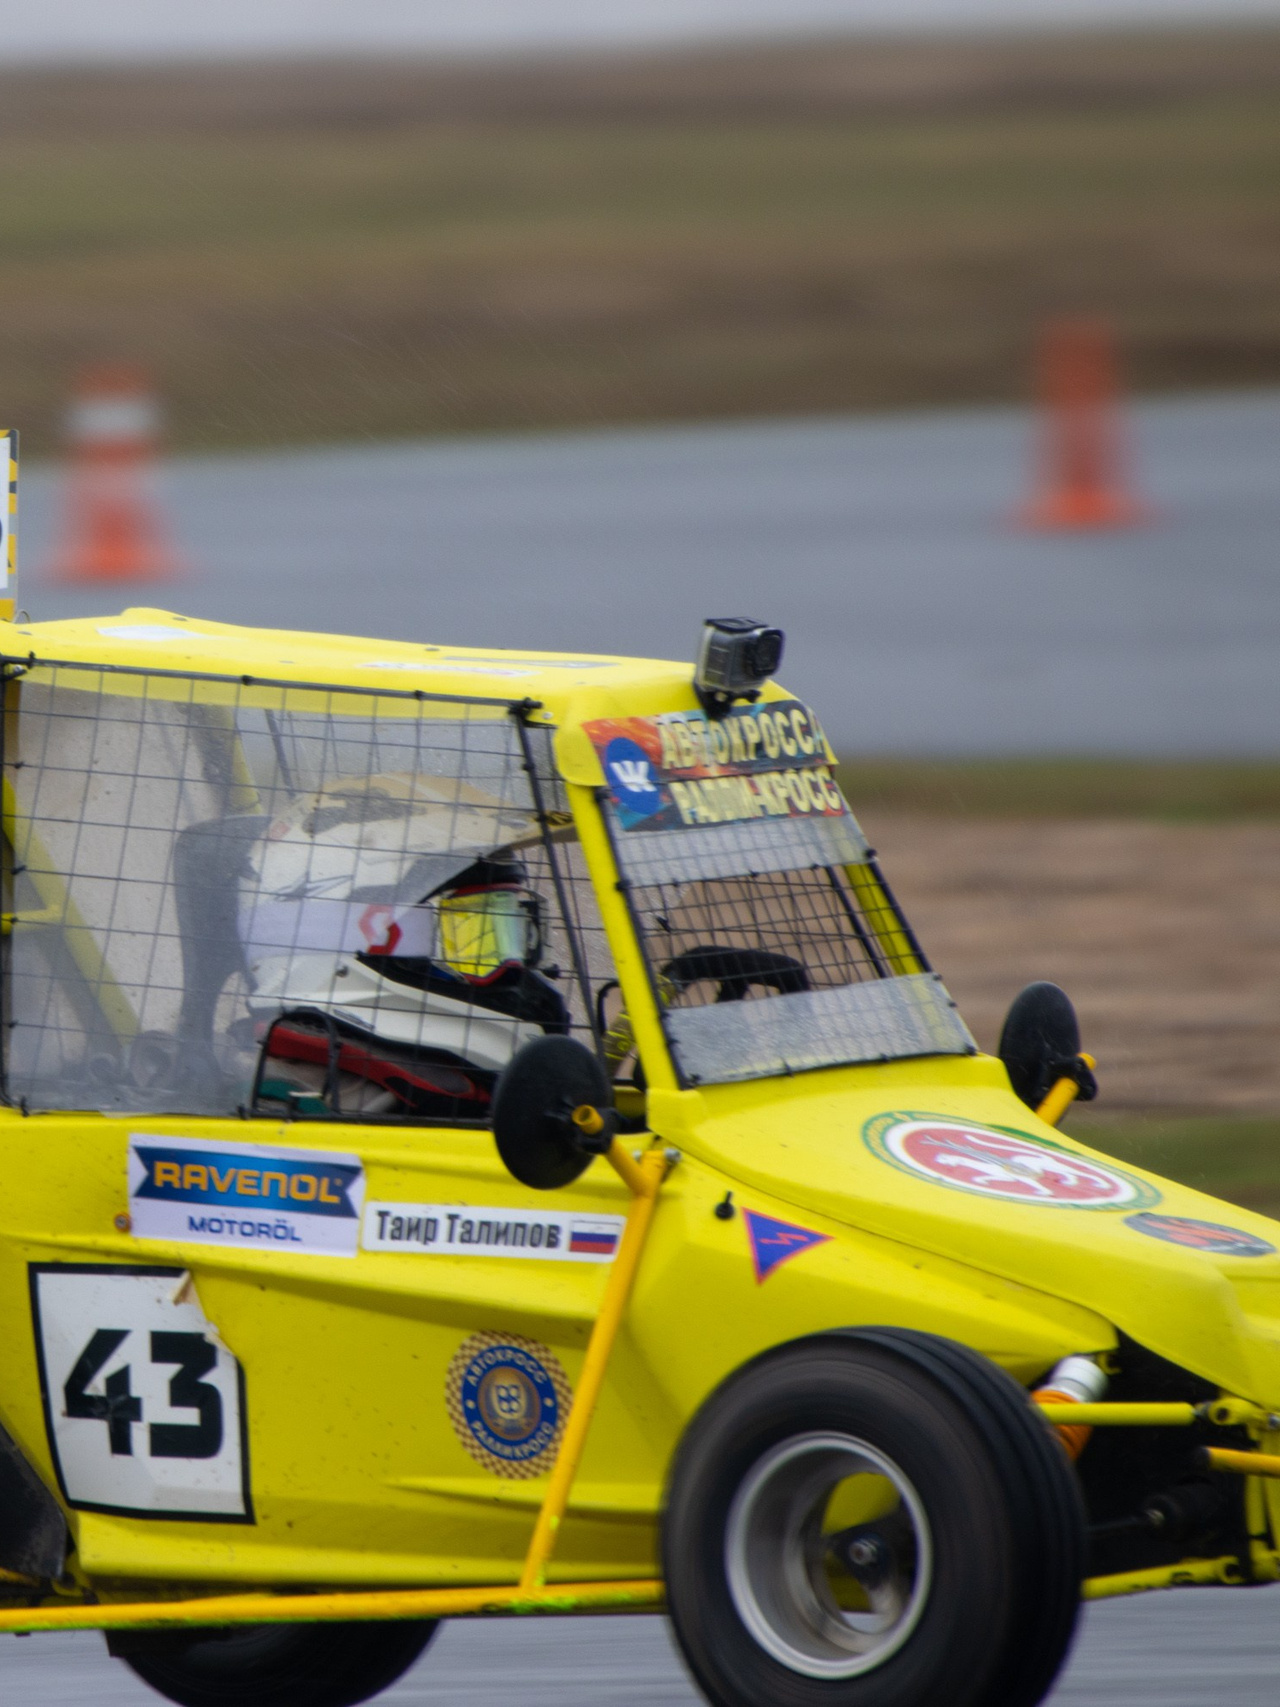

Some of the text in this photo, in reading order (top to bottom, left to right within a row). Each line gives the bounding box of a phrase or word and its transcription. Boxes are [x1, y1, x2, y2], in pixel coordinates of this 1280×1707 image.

[188, 1215, 302, 1242] MOTORÖL
[376, 1210, 562, 1249] Таир Талипов
[466, 1348, 548, 1387] АВТОКРОСС
[63, 1328, 224, 1459] 43
